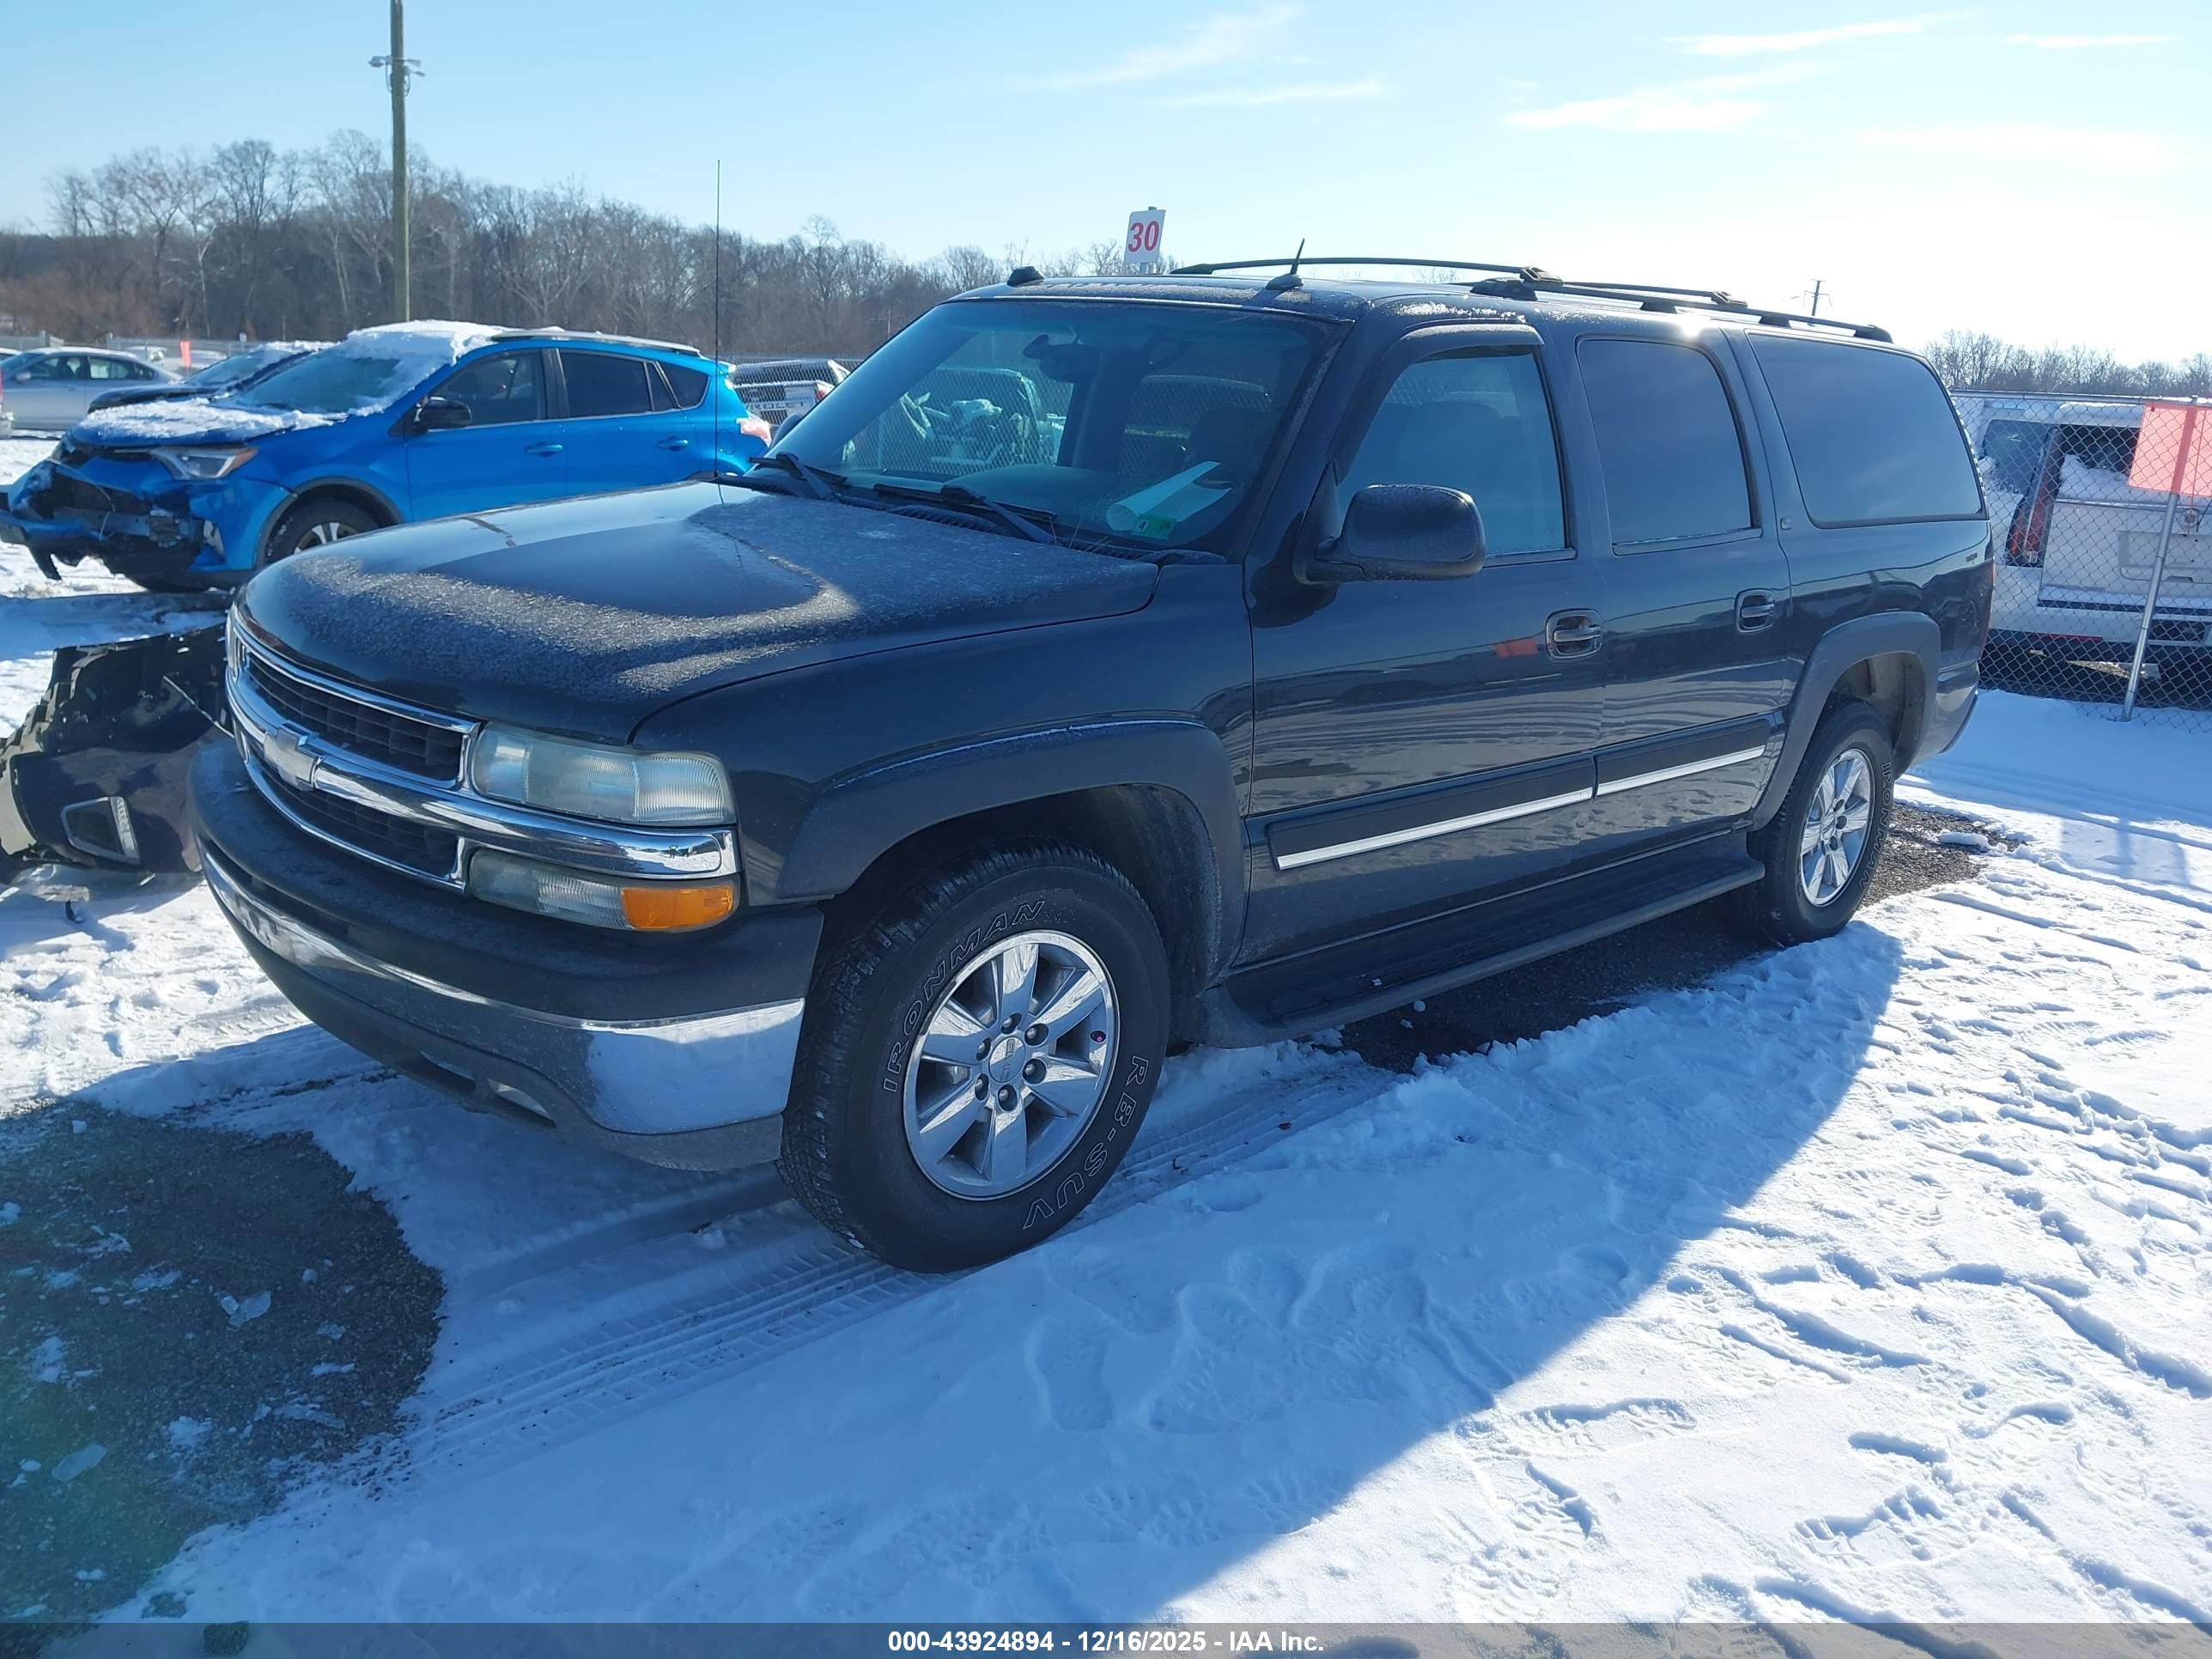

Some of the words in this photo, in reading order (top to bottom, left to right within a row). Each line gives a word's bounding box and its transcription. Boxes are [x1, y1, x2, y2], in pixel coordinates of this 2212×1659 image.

[1127, 220, 1159, 252] 30
[1858, 762, 1893, 890] IRONMAN
[883, 901, 1045, 1092] IRONMAN
[1023, 1055, 1149, 1230] RB-SUV
